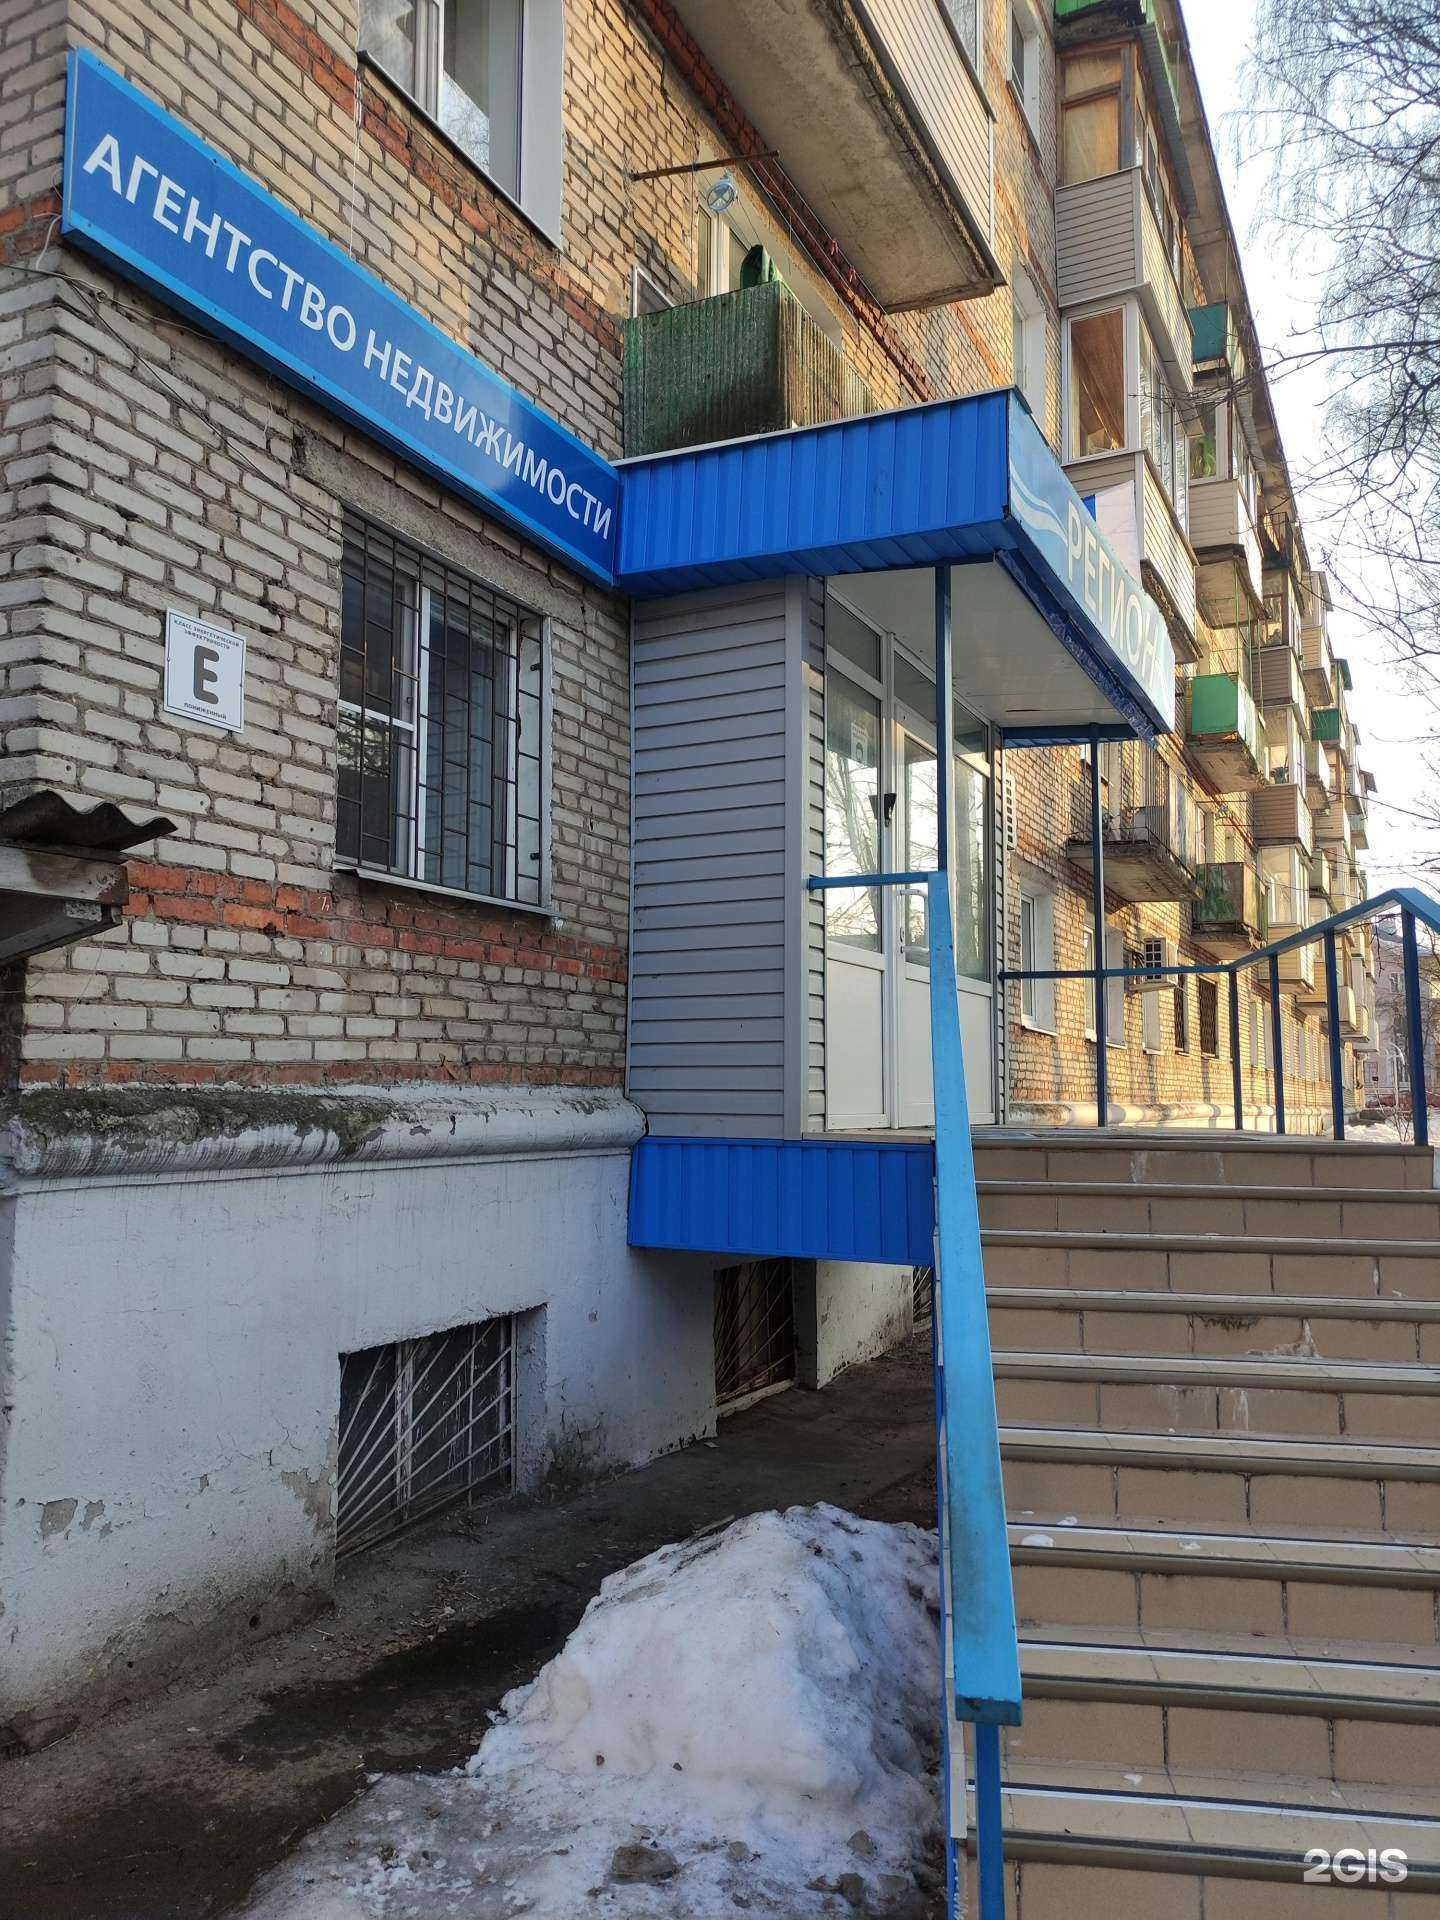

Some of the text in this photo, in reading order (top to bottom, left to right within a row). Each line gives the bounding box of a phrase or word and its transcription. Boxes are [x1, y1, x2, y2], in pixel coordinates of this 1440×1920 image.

[83, 134, 611, 539] АГЕНТСТВО НЕДВИЖИМОСТИ
[174, 619, 193, 630] КЛАСС
[1068, 501, 1158, 689] РЕГИОН
